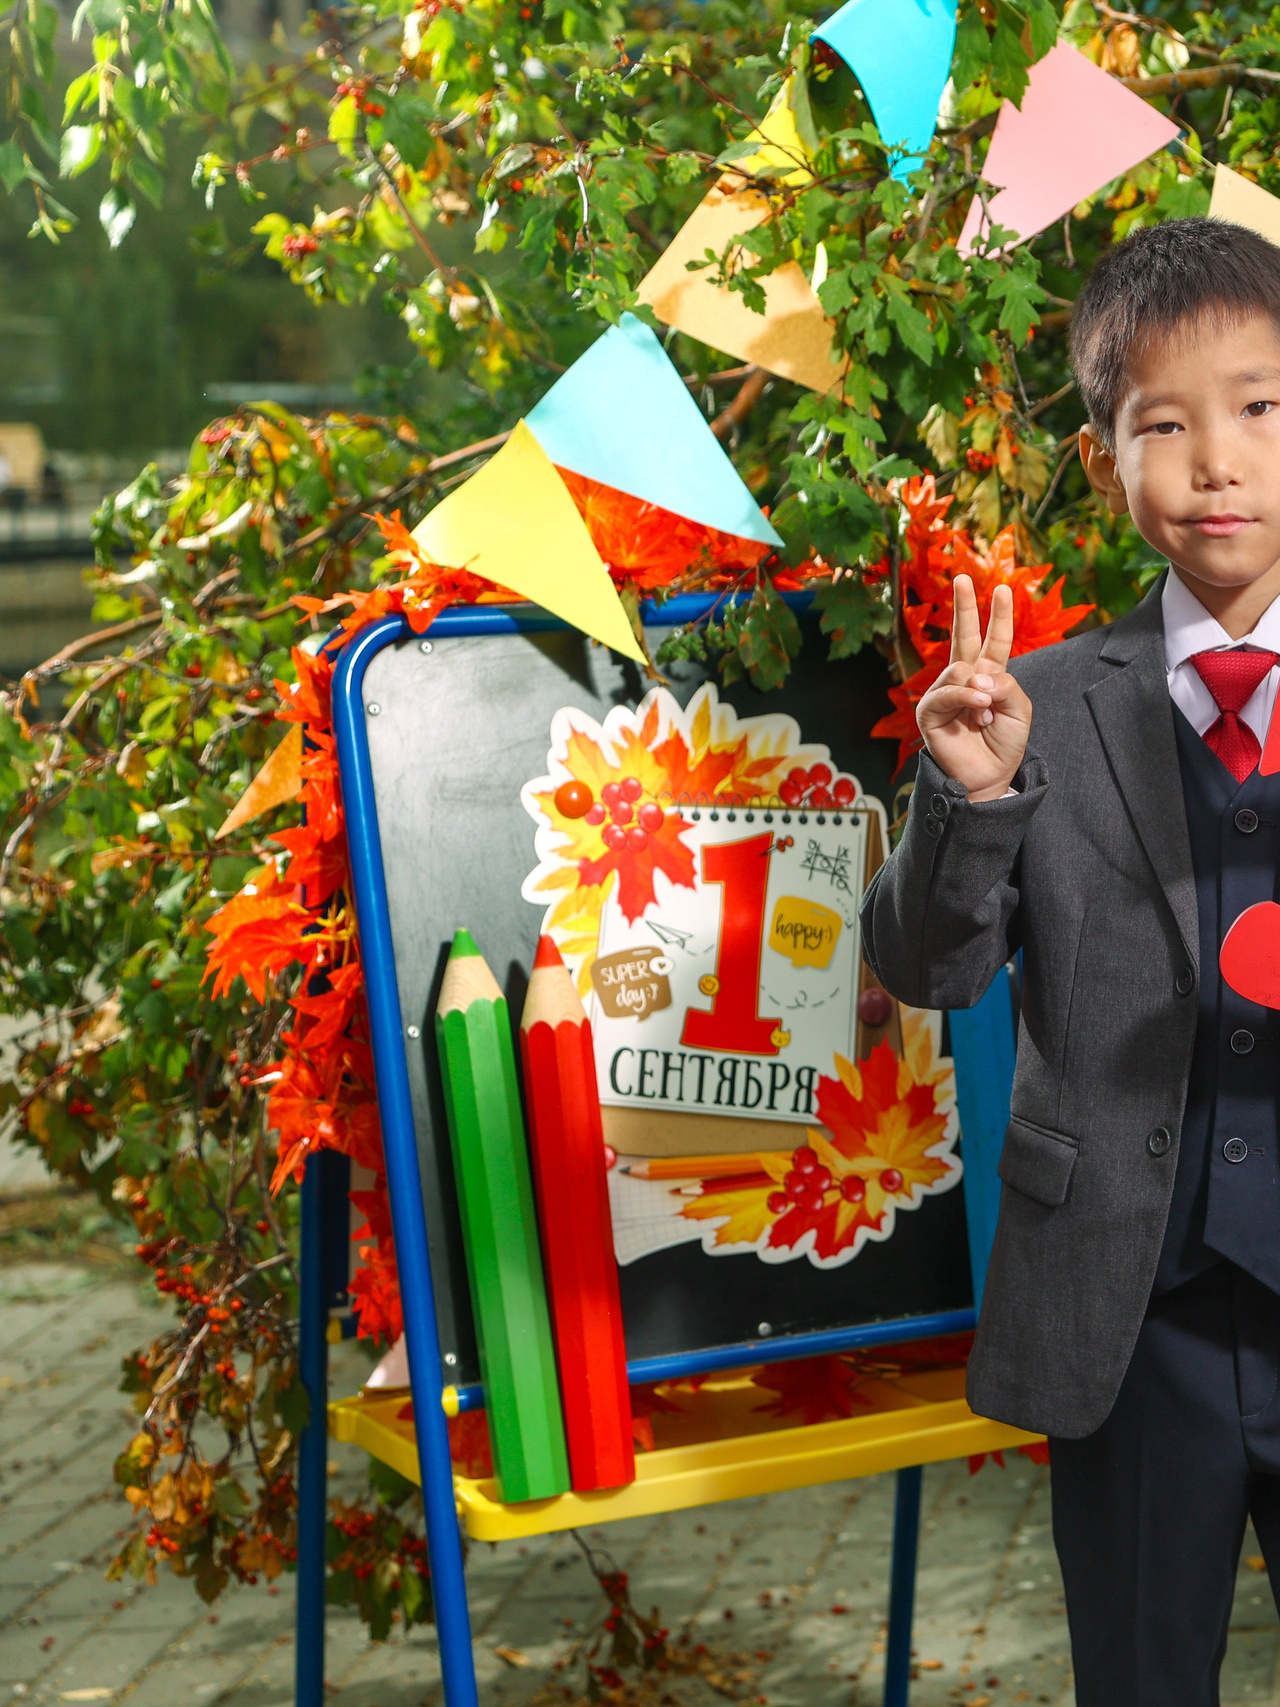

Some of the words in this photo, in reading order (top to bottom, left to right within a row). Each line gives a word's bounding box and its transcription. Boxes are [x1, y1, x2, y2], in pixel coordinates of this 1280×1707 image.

[600, 960, 650, 986] SUPER
[680, 830, 783, 1056] 1
[609, 1046, 817, 1115] СЕНТЯБРЯ
